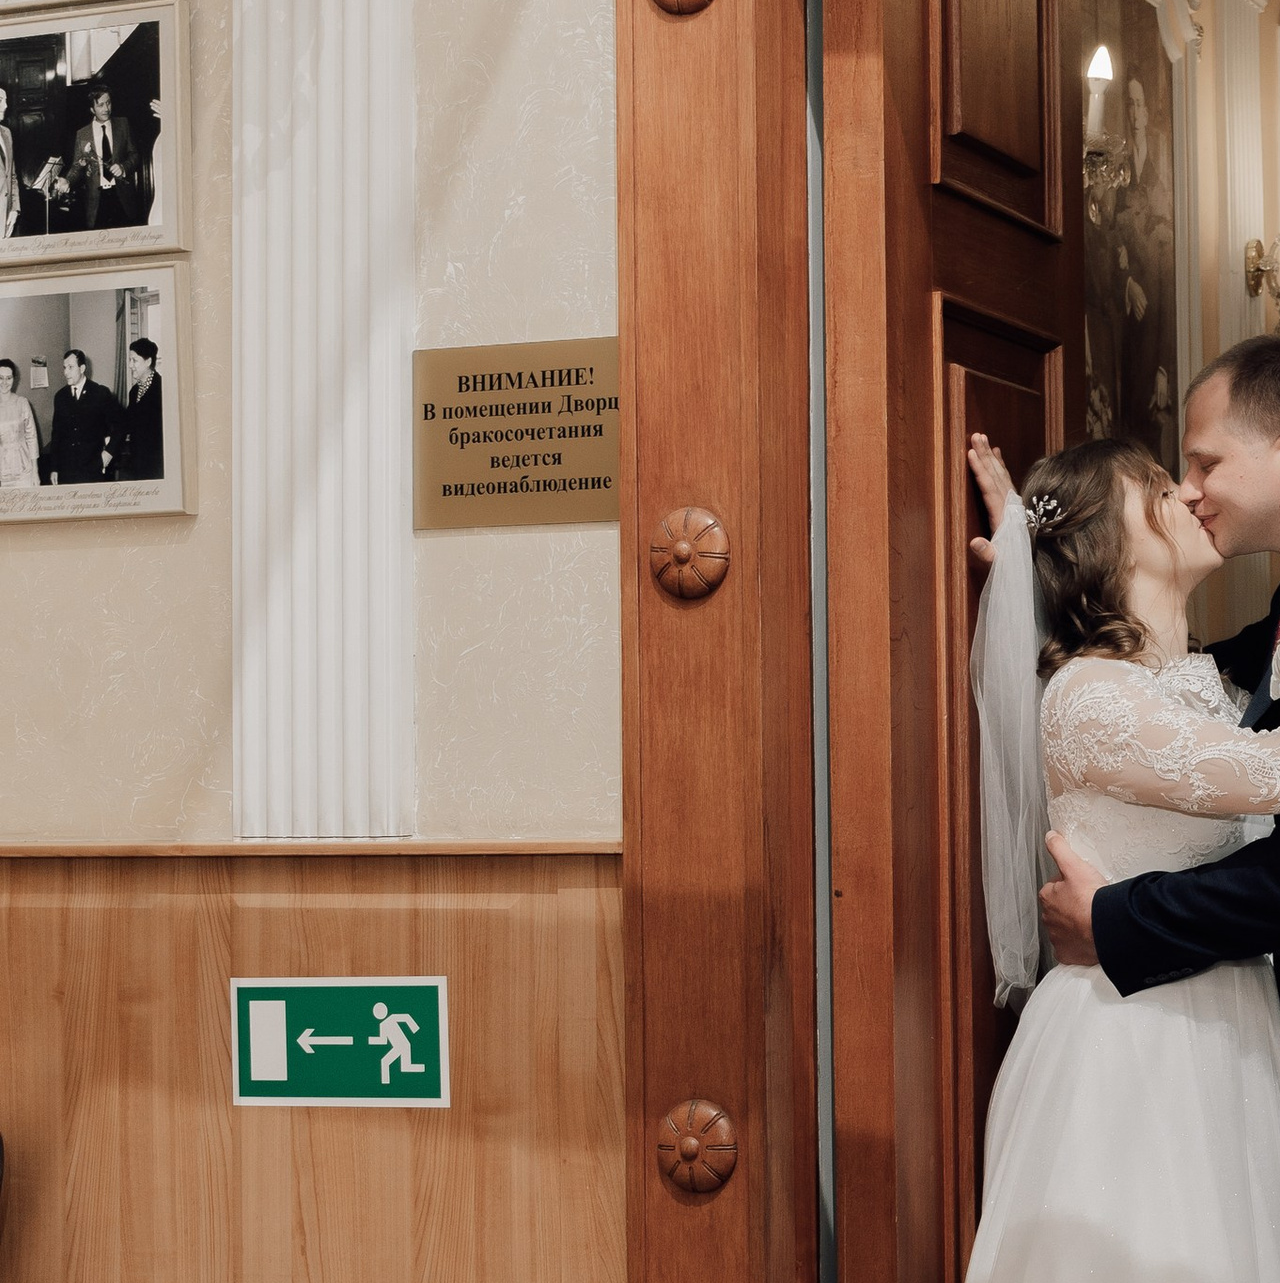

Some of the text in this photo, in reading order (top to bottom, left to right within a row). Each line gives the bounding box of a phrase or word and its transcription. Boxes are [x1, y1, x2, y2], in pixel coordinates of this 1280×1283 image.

[457, 366, 594, 393] ВНИМАНИЕ!
[422, 394, 620, 421] В помещении Дворц
[448, 423, 604, 449] бракосочетания
[490, 452, 563, 469] ведется
[441, 474, 613, 497] видеонаблюдение
